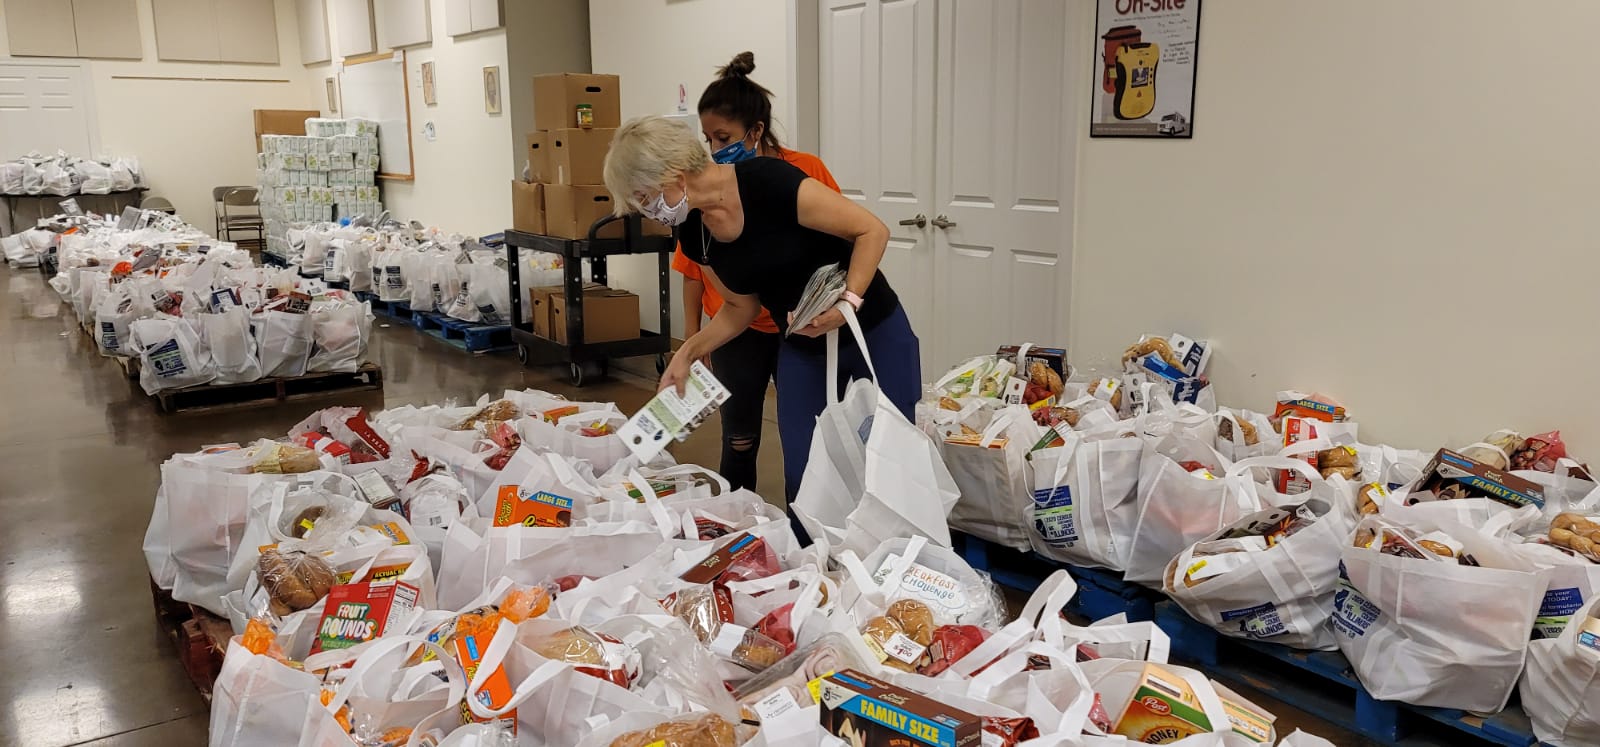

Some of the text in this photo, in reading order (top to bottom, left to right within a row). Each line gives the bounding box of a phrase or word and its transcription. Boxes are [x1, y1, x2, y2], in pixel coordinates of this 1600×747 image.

[1471, 478, 1509, 497] FAMILY
[536, 493, 555, 504] LARGE
[337, 604, 368, 619] FRUIT
[320, 617, 377, 642] ROUNDS
[1146, 697, 1168, 711] Post
[860, 699, 907, 731] FAMILY
[909, 719, 939, 744] SIZE
